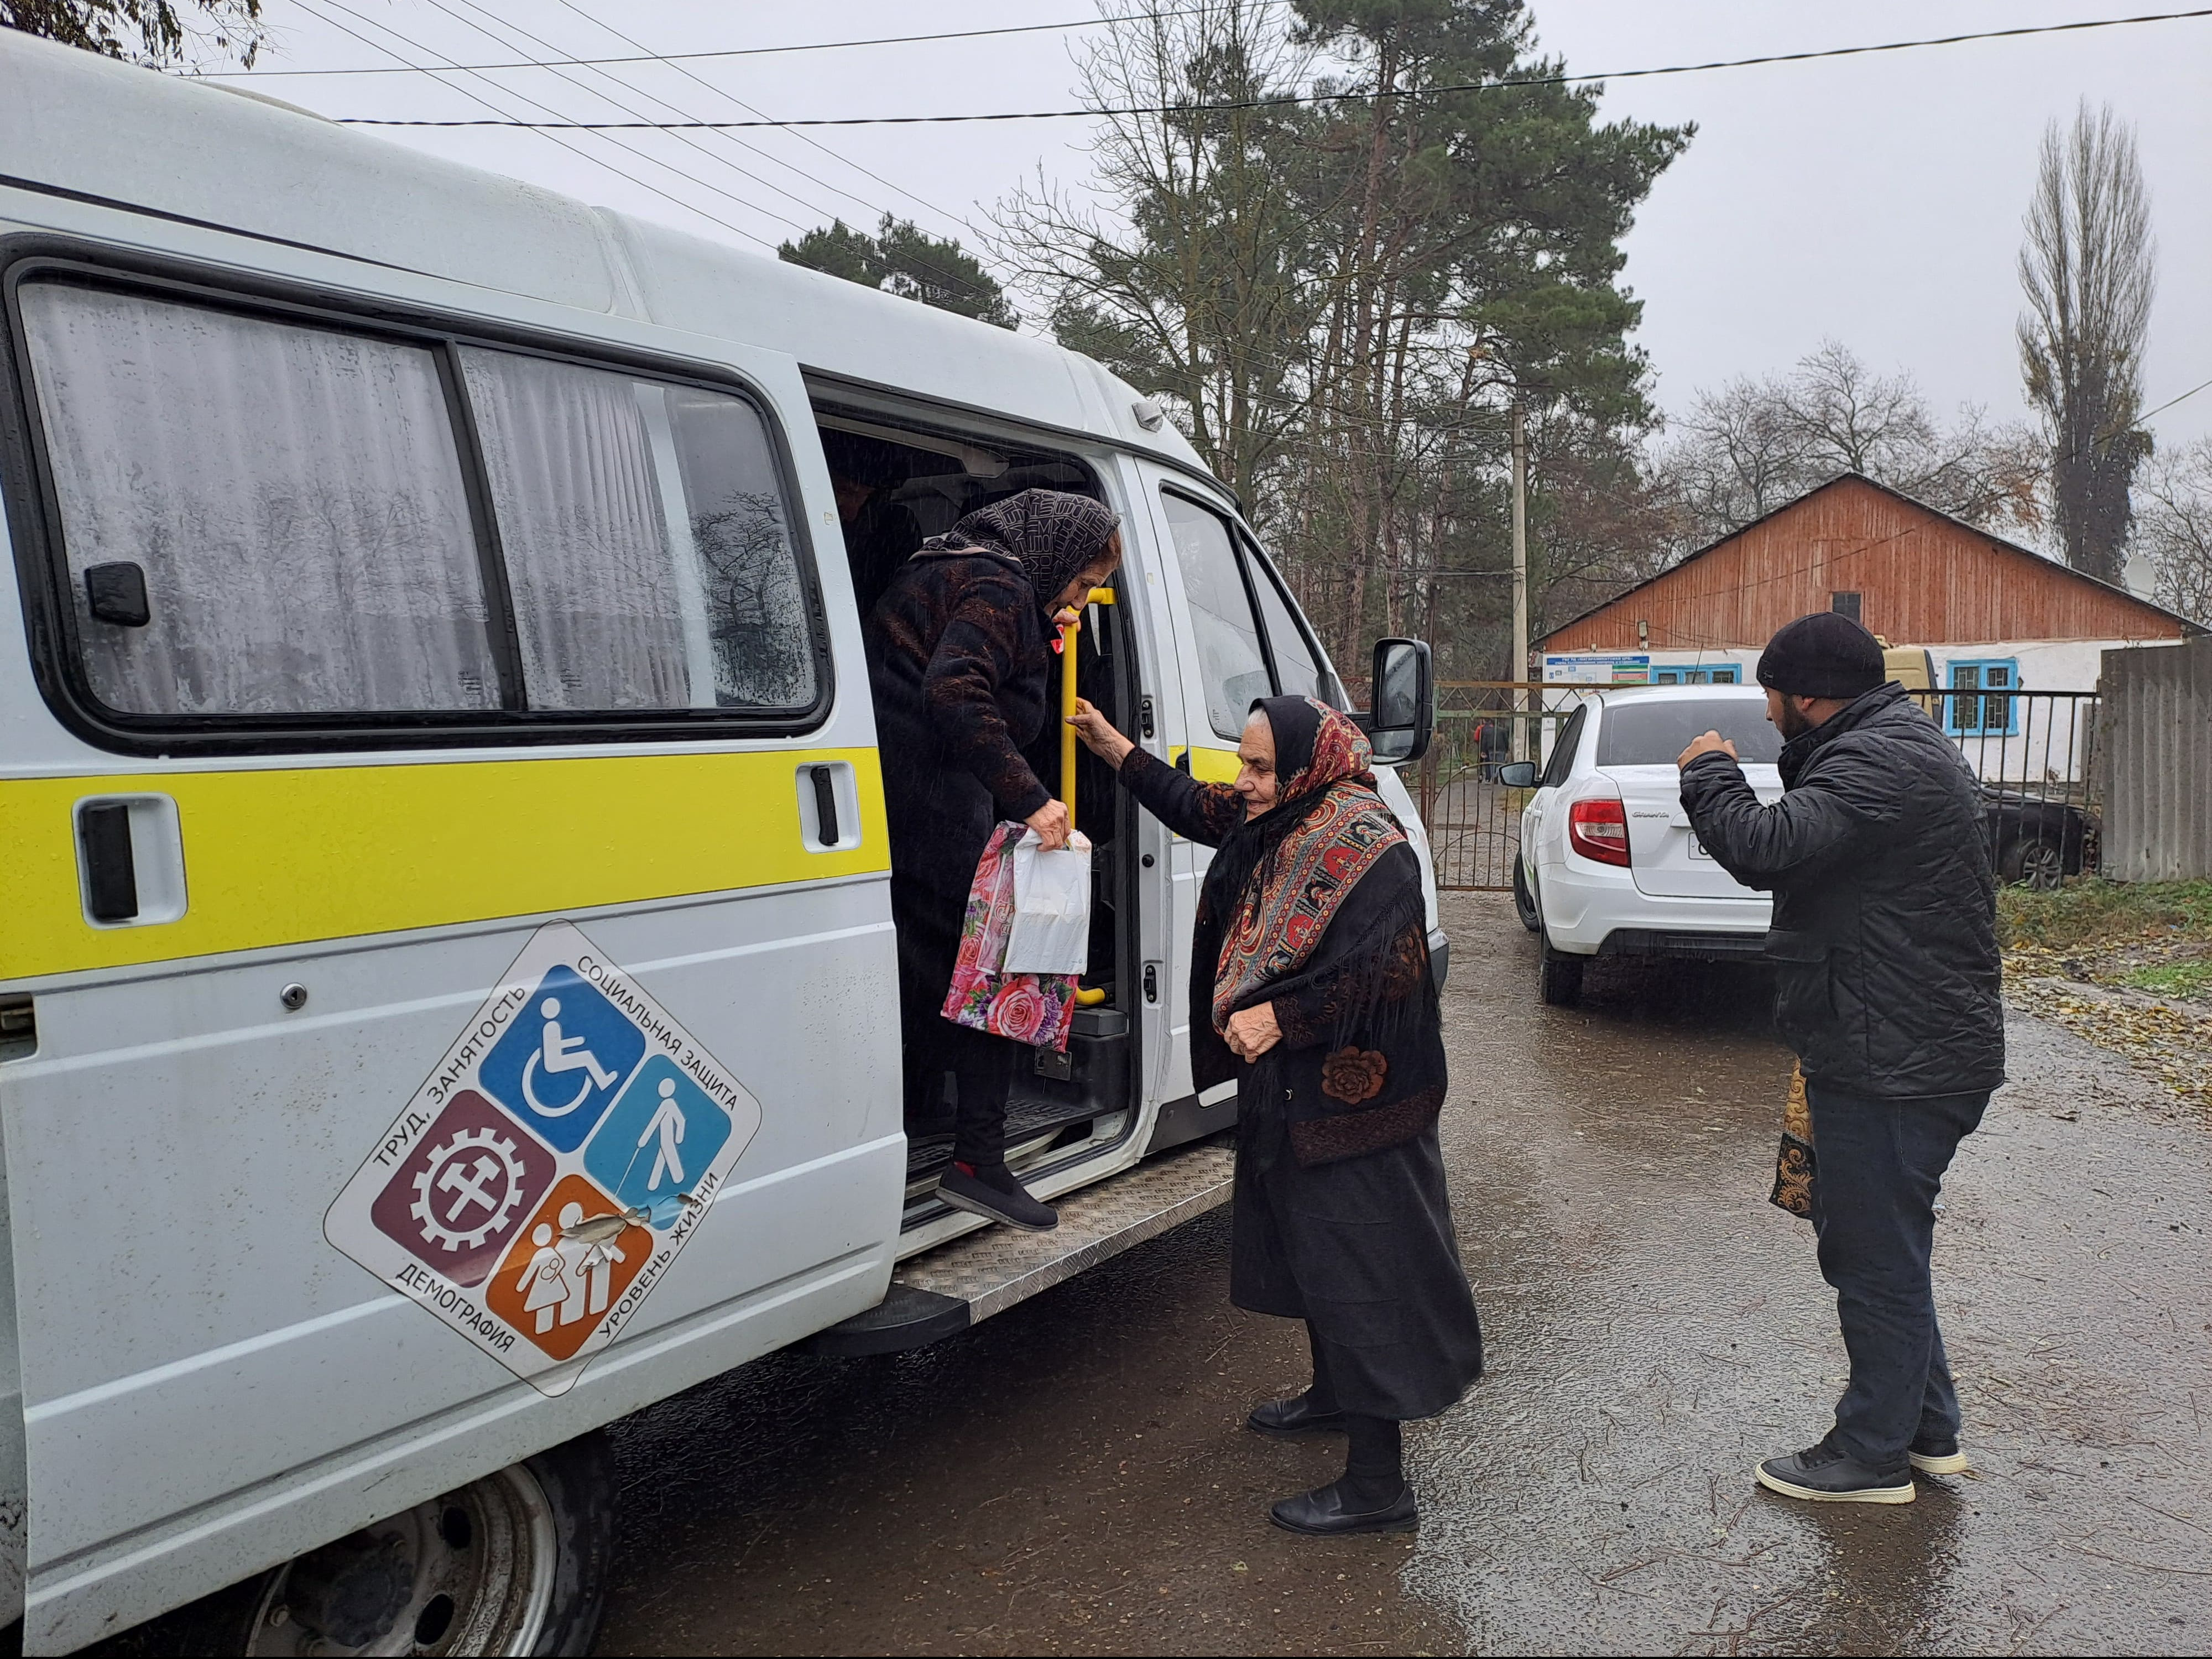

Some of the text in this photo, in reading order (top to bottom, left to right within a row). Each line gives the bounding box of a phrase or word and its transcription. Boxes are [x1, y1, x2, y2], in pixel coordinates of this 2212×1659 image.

[373, 987, 525, 1167] ТРУД, ЗАНЯТОСТЬ
[577, 955, 738, 1111] СОЦИАЛЬНАЯ ЗАЩИТА
[395, 1263, 515, 1353] ДЕМОГРАФИЯ
[598, 1172, 718, 1338] УРОВЕНЬ ЖИЗНИ
